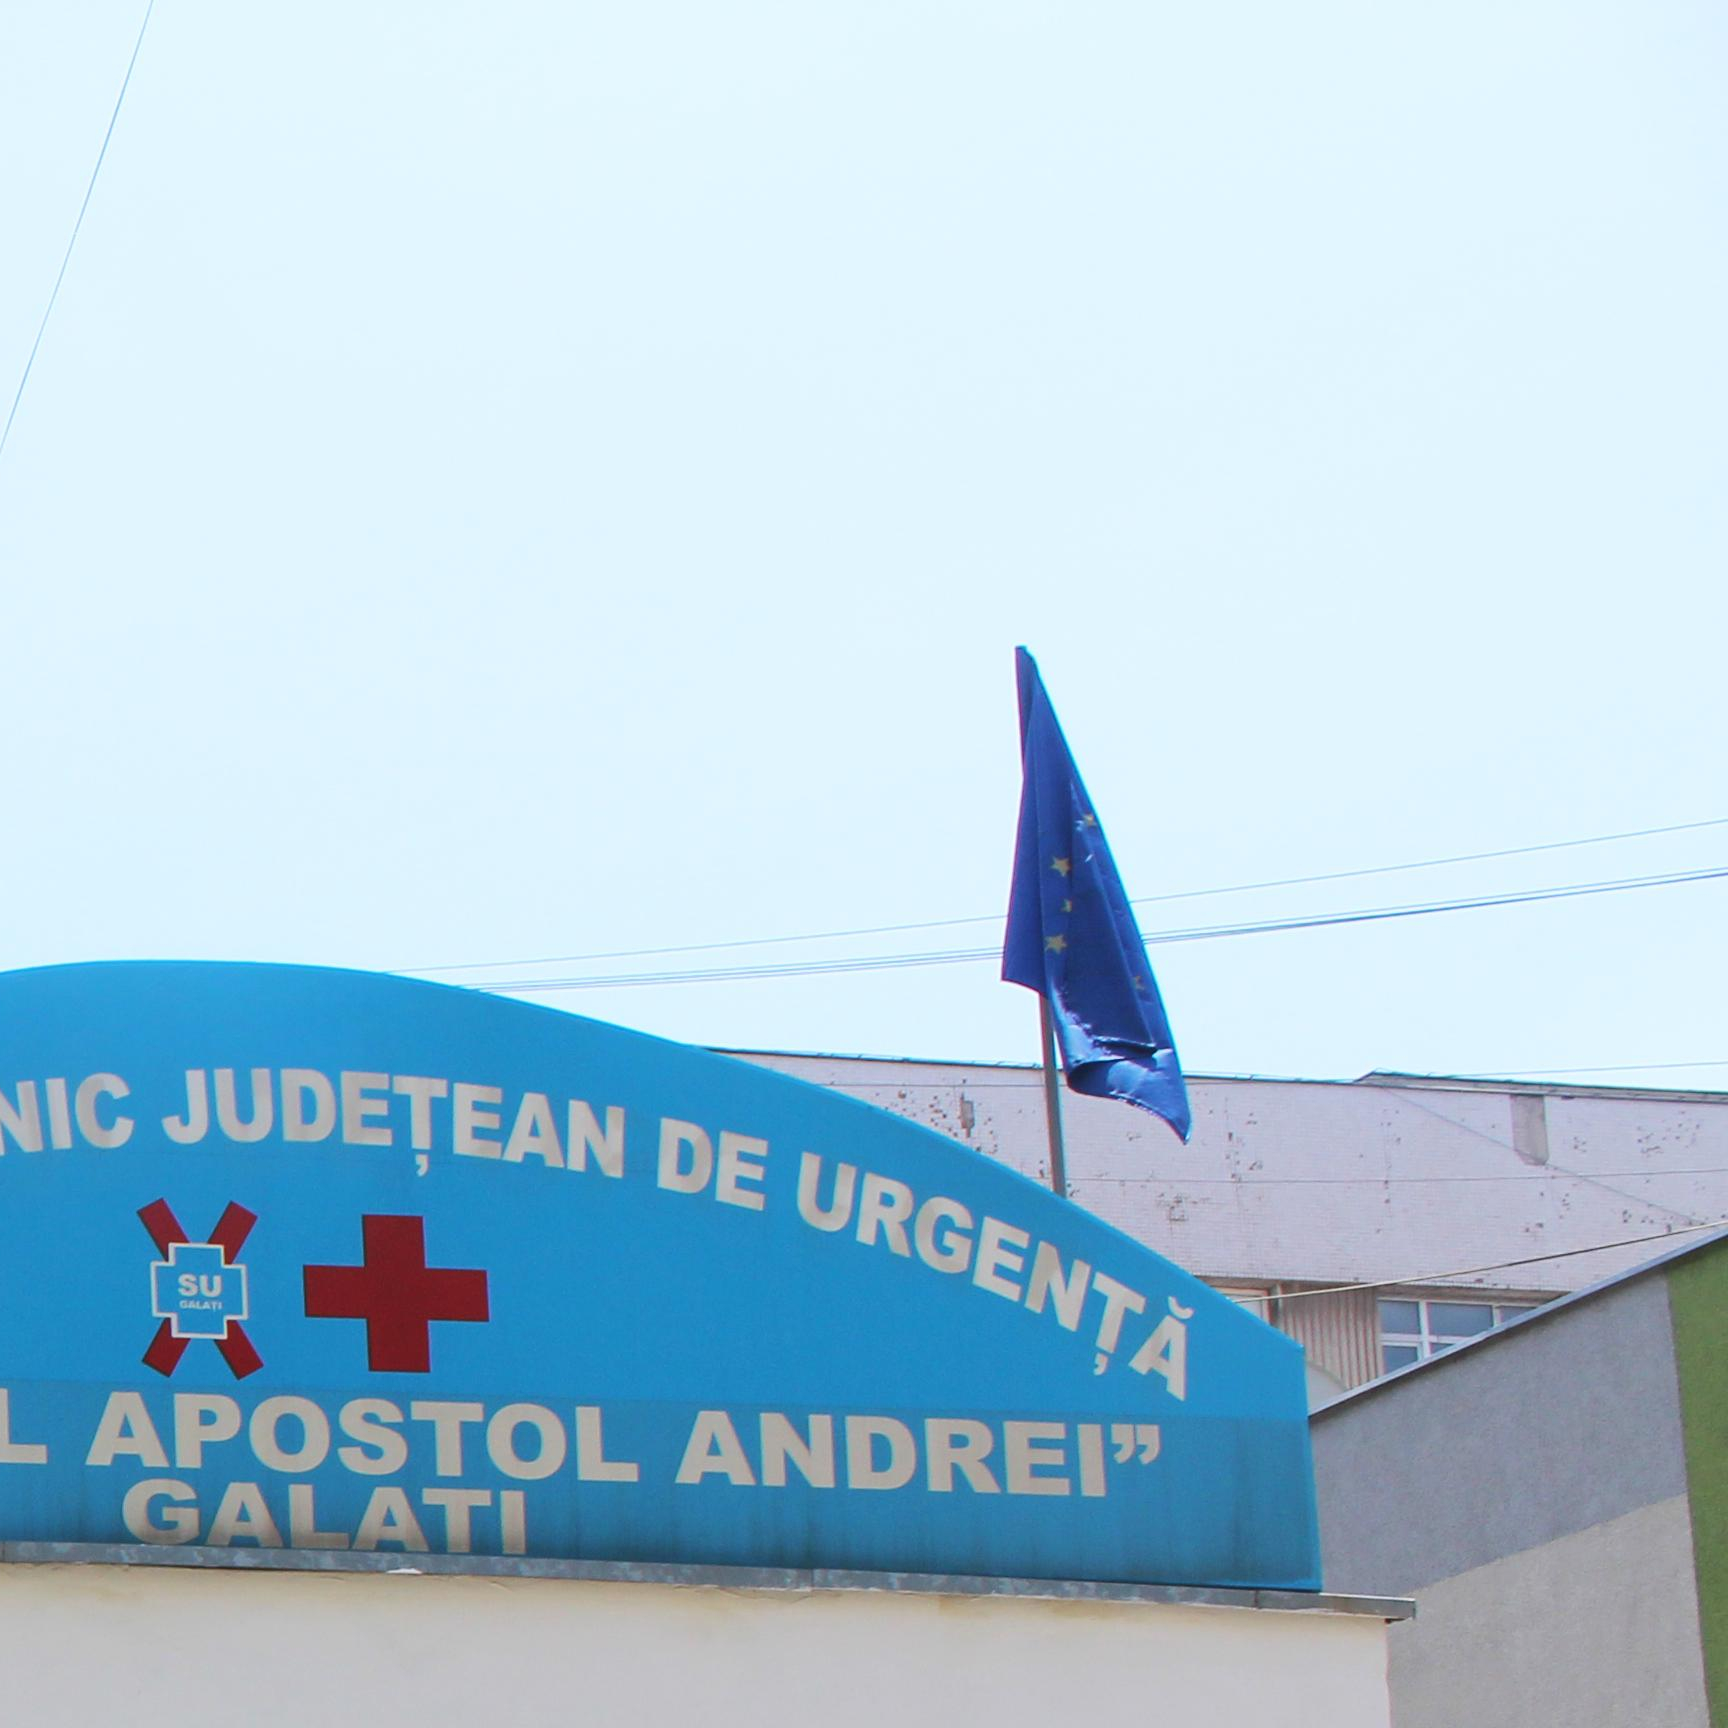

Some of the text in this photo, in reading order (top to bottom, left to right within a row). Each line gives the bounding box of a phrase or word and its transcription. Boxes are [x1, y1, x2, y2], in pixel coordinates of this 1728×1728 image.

[162, 1067, 626, 1178] JUDEȚEAN
[655, 1117, 770, 1211] DE
[795, 1150, 1195, 1401] URGENȚĂ
[177, 1273, 223, 1298] SU
[85, 1390, 640, 1483] APOSTOL
